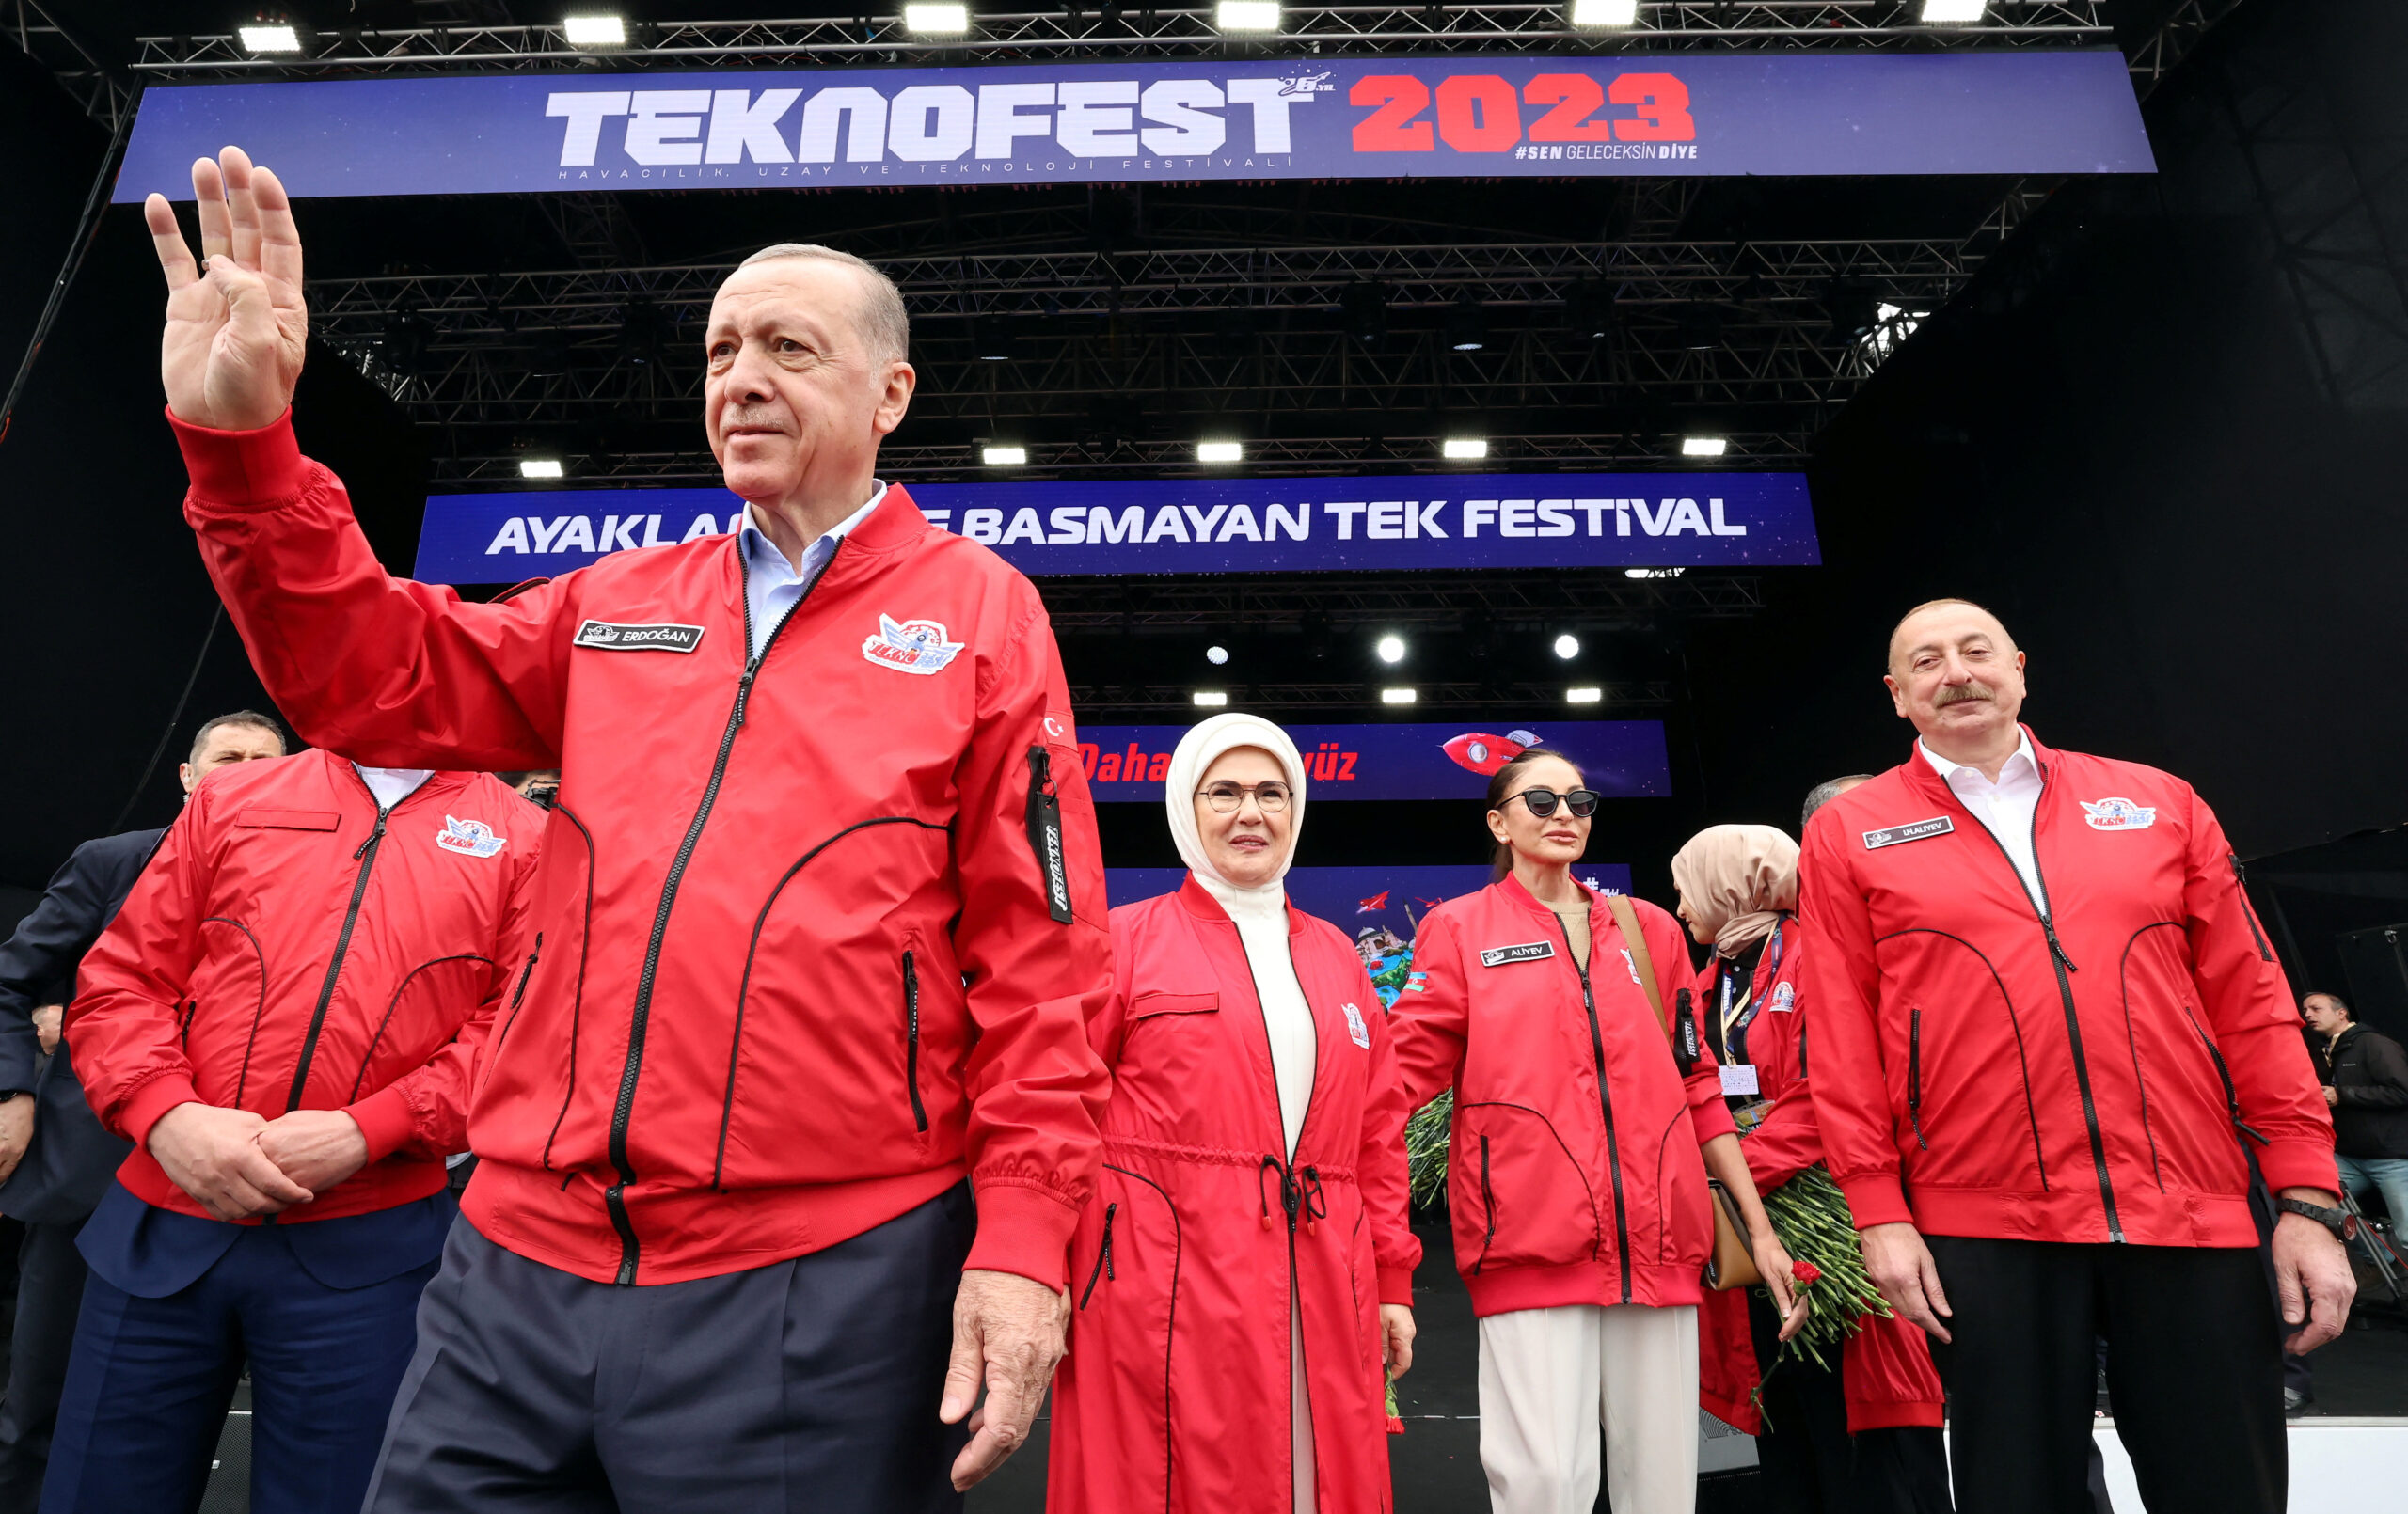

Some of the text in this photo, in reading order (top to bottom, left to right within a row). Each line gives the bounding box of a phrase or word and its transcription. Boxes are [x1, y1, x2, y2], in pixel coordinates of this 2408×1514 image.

[546, 73, 1696, 166] TEKNOFEST 2023
[758, 166, 832, 177] UZAY
[860, 165, 889, 175] VE
[918, 158, 1093, 174] TEKNOLOJİ
[1123, 156, 1291, 169] FESTİVALİ
[1515, 141, 1698, 160] #SEN GELECEKSİN DİYE
[485, 513, 742, 555] AYAKLA
[961, 503, 1310, 545] BASMAYAN
[1324, 500, 1449, 540] TEK
[622, 628, 690, 642] ERDOĞAN
[1078, 743, 1171, 782] Daha
[1045, 824, 1068, 911] TEKNOFEST
